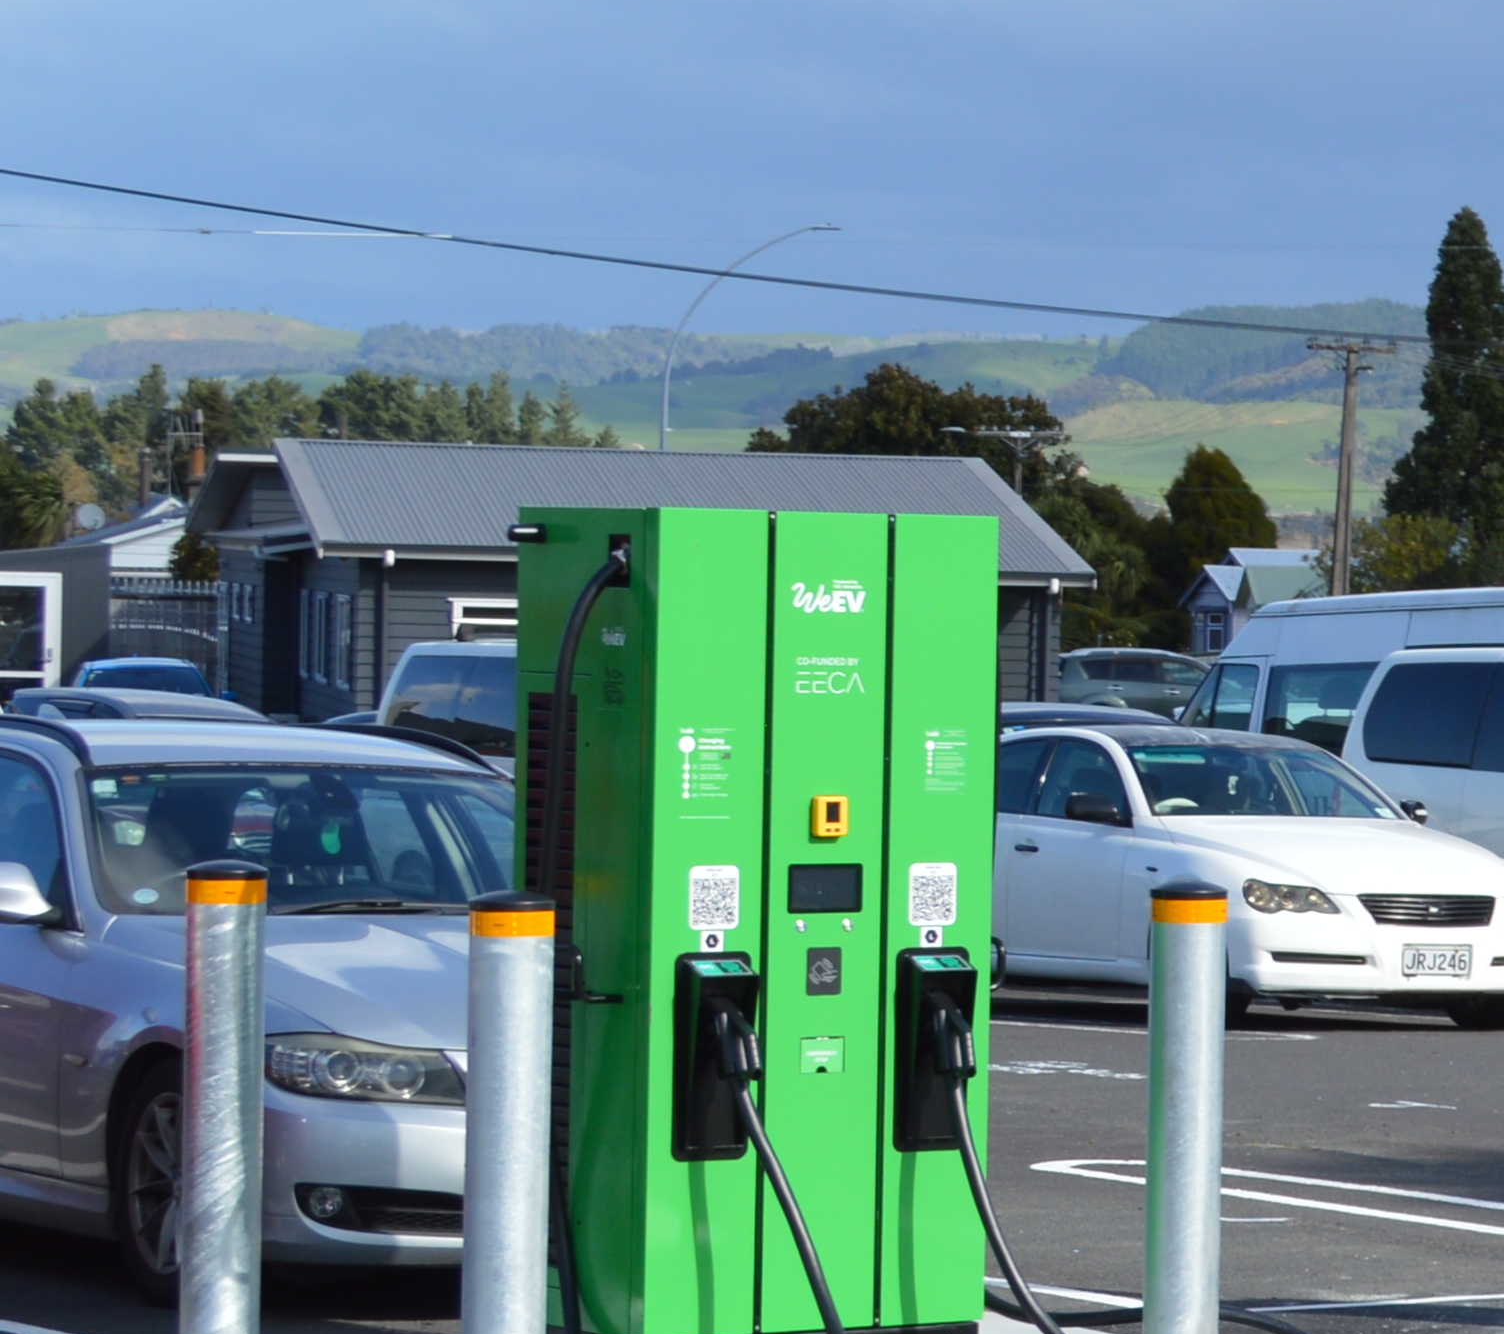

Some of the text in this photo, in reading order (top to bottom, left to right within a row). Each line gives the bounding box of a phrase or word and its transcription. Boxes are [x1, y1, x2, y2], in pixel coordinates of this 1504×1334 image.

[791, 582, 866, 614] WeEV
[796, 657, 860, 666] CO-FUNDED BY
[795, 671, 865, 694] EECA
[1405, 953, 1468, 971] JRJ246
